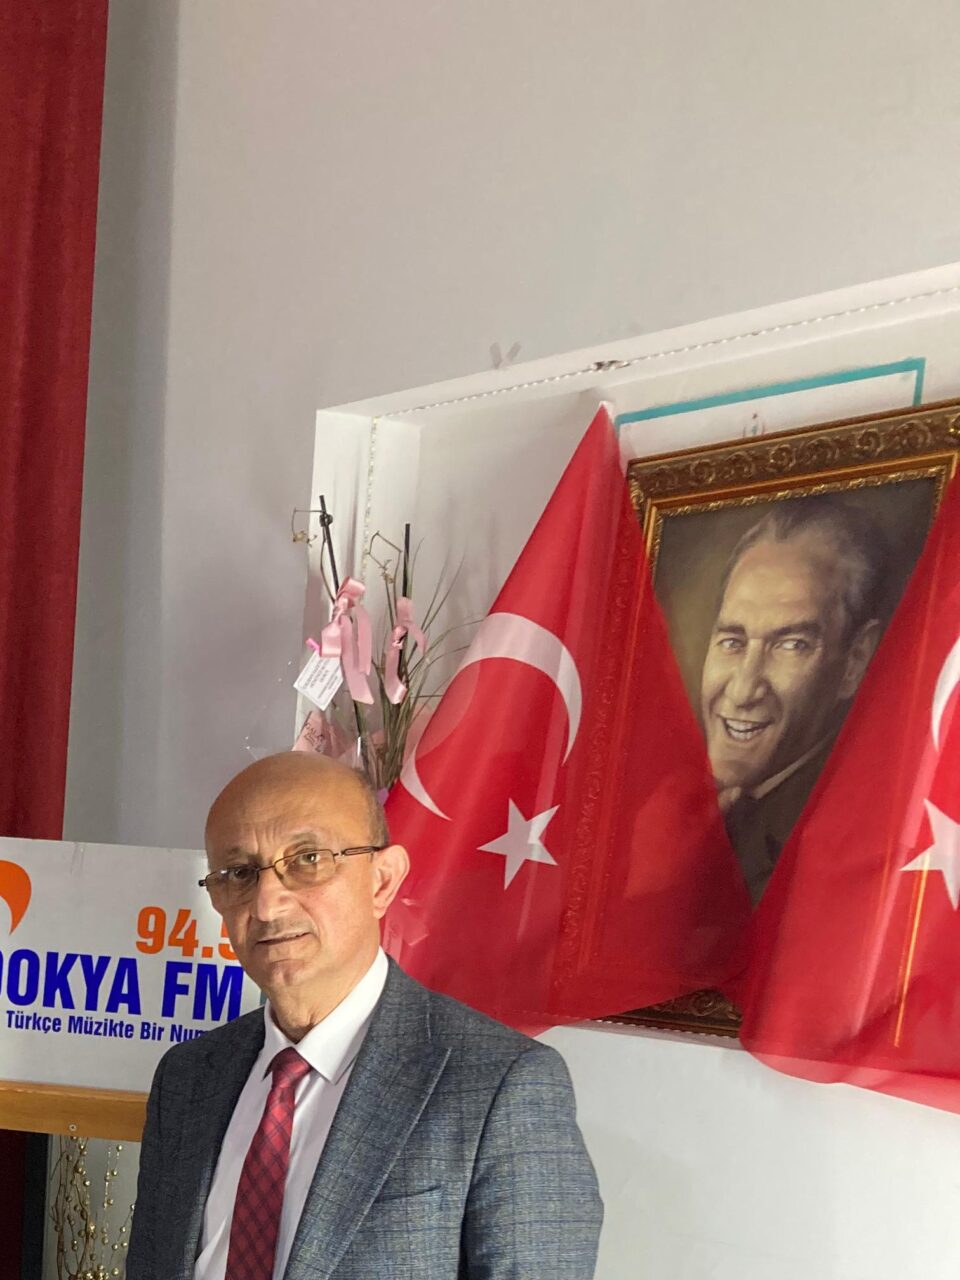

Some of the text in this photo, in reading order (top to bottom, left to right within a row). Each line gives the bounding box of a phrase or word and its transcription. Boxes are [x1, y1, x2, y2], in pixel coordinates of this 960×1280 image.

[161, 960, 244, 1023] FM
[6, 1009, 62, 1034] Türkçe
[67, 1015, 135, 1039] Müzikte
[140, 1021, 165, 1041] Bir
